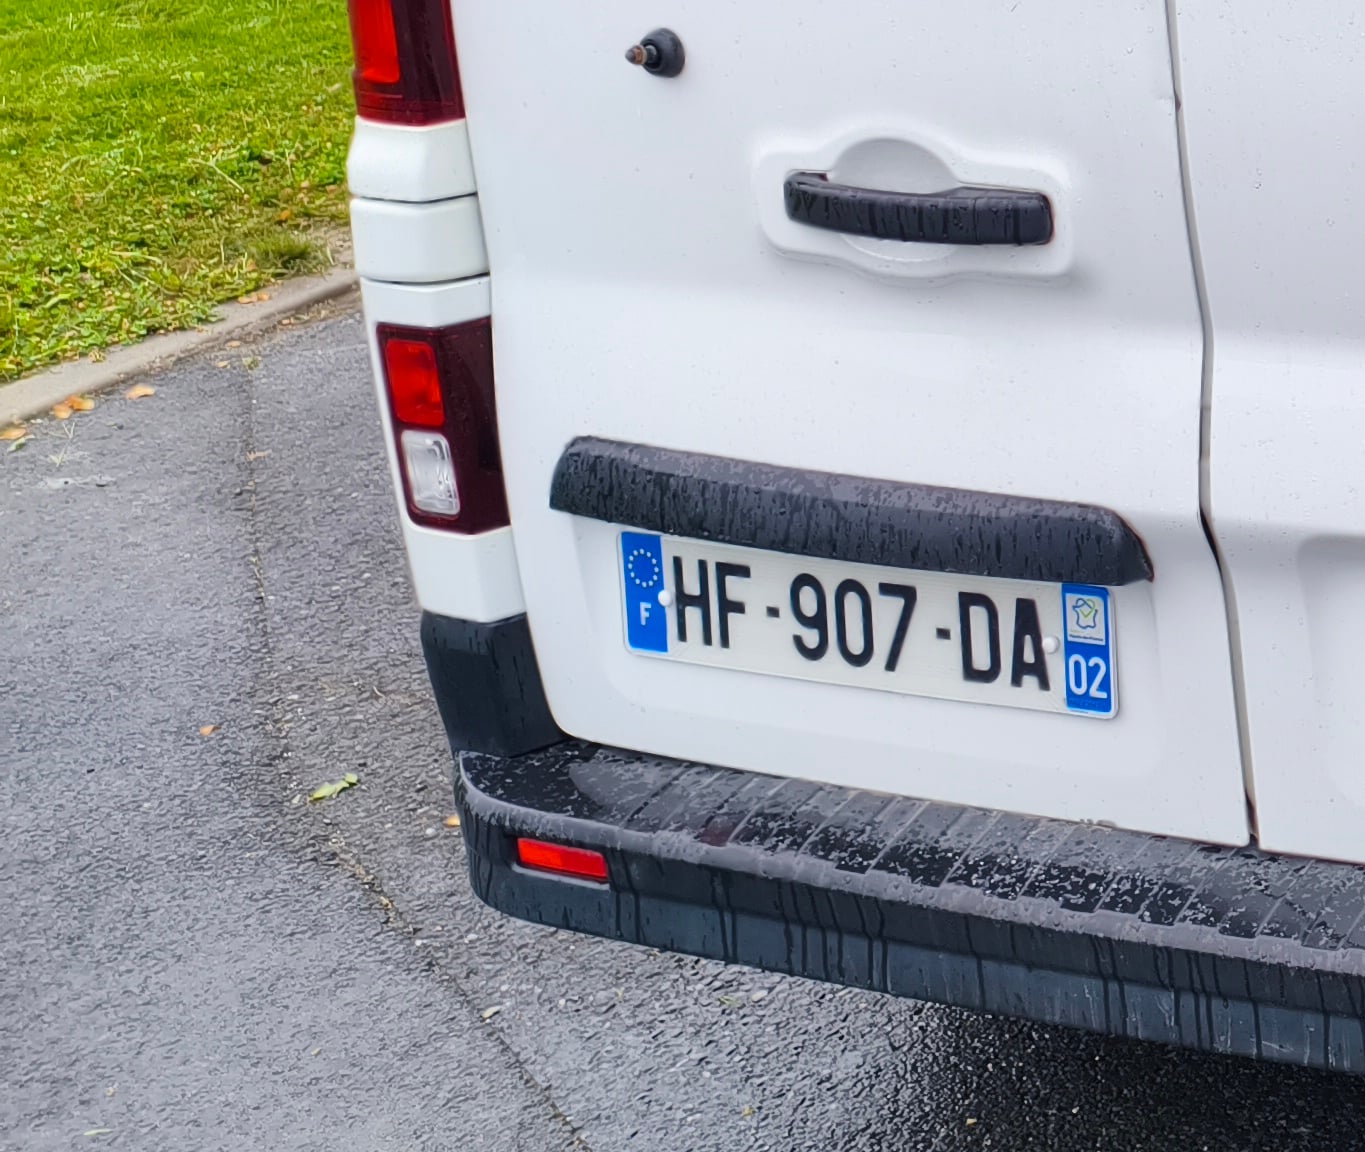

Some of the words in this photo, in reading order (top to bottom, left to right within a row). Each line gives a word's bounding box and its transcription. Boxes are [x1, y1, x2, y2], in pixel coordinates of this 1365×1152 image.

[639, 601, 652, 626] F
[672, 555, 1051, 691] HF-907-DA
[1068, 653, 1108, 699] 02
